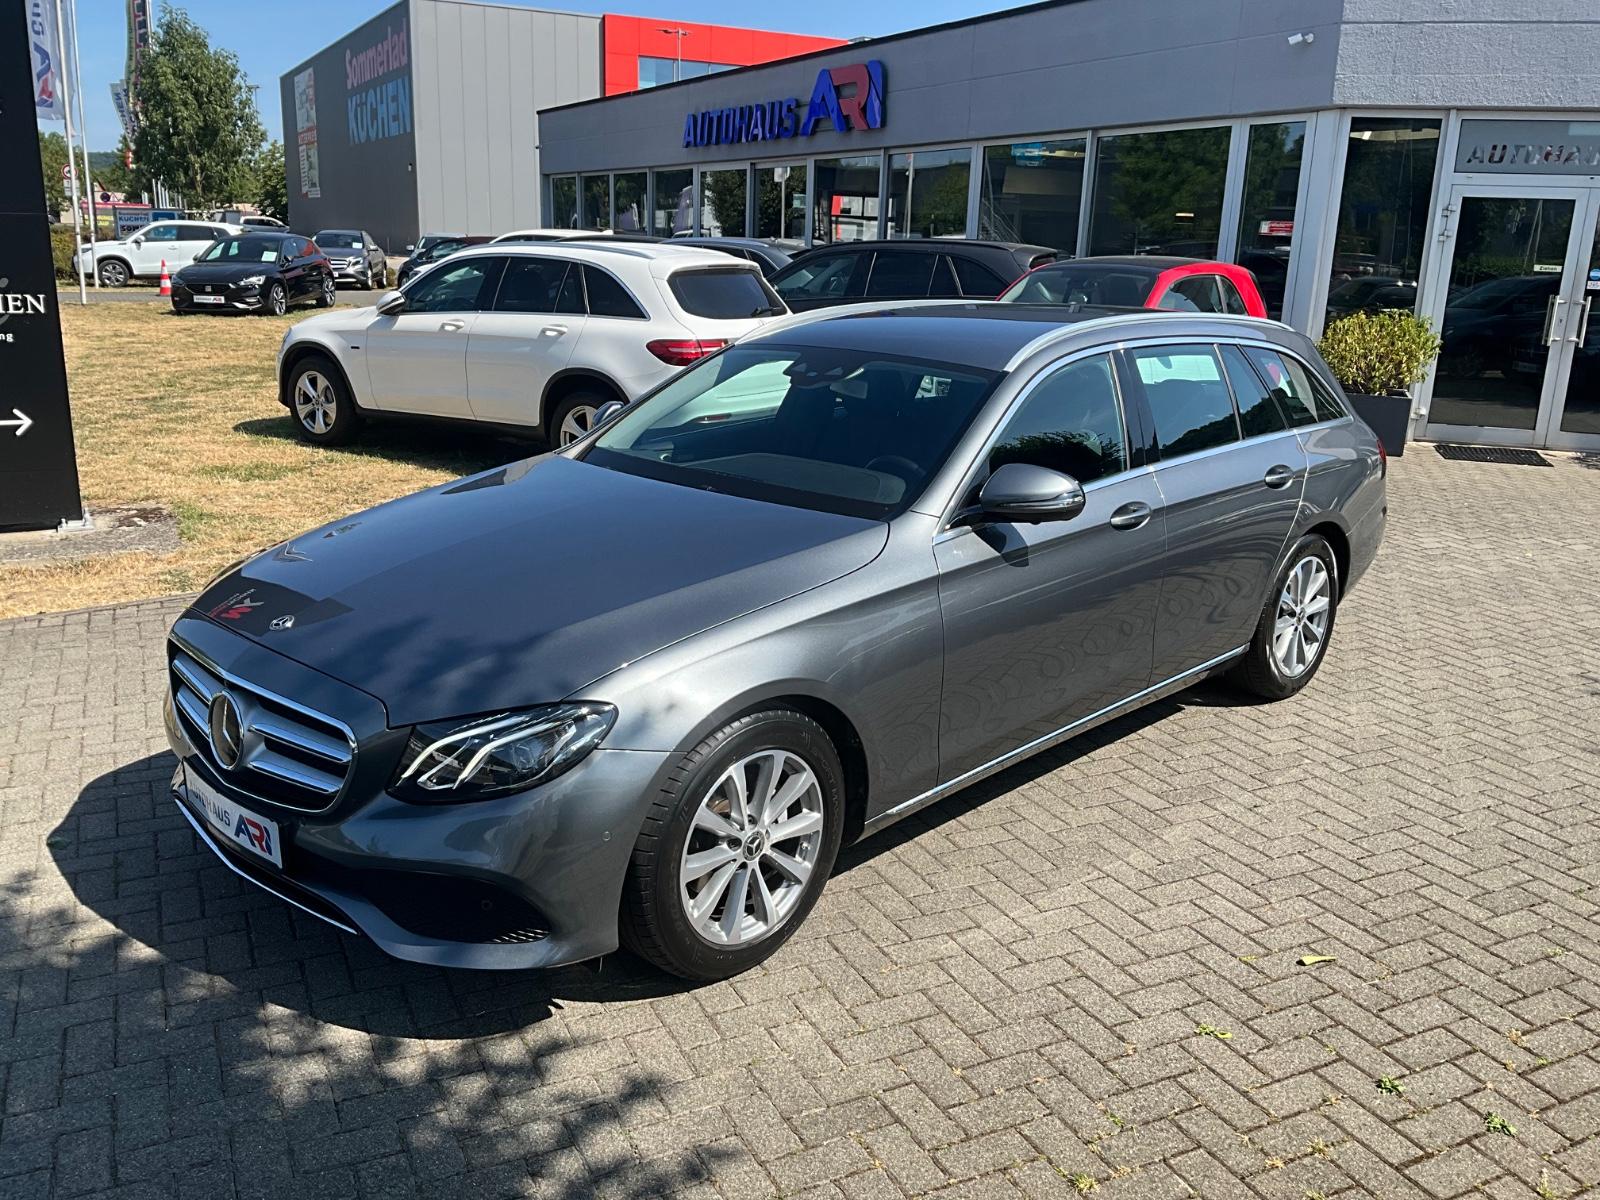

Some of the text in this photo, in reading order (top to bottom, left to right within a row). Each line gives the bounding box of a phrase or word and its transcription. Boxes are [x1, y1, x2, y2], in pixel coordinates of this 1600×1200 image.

[345, 17, 408, 90] Sommerlad
[683, 60, 886, 149] AUTOHAUS ARI
[234, 814, 273, 857] ARI
